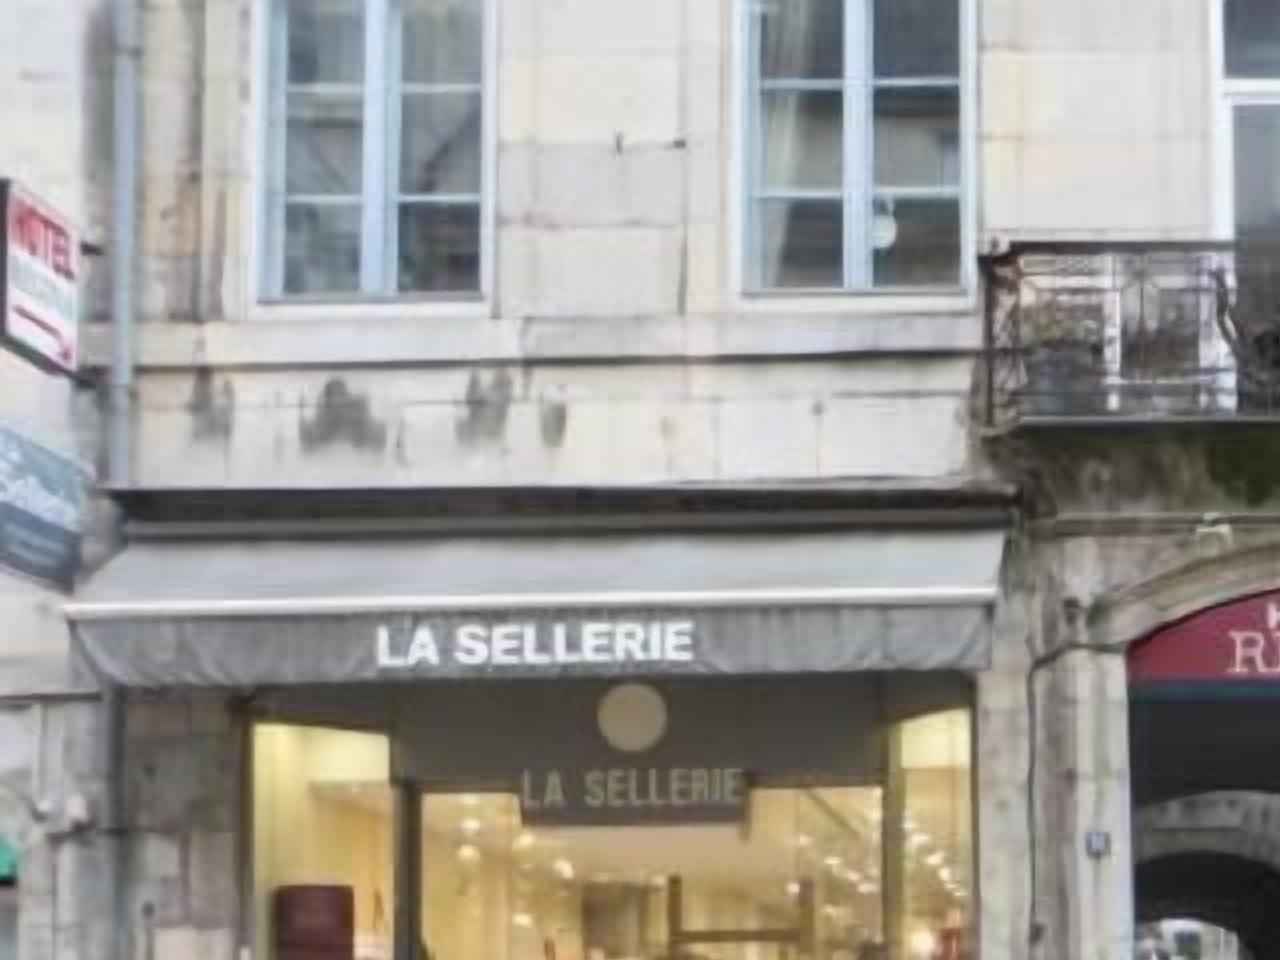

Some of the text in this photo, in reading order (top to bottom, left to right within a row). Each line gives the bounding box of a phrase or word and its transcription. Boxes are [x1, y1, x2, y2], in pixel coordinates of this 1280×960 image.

[377, 621, 695, 666] LA SELLERIE
[522, 766, 743, 808] LA SELLERIE
